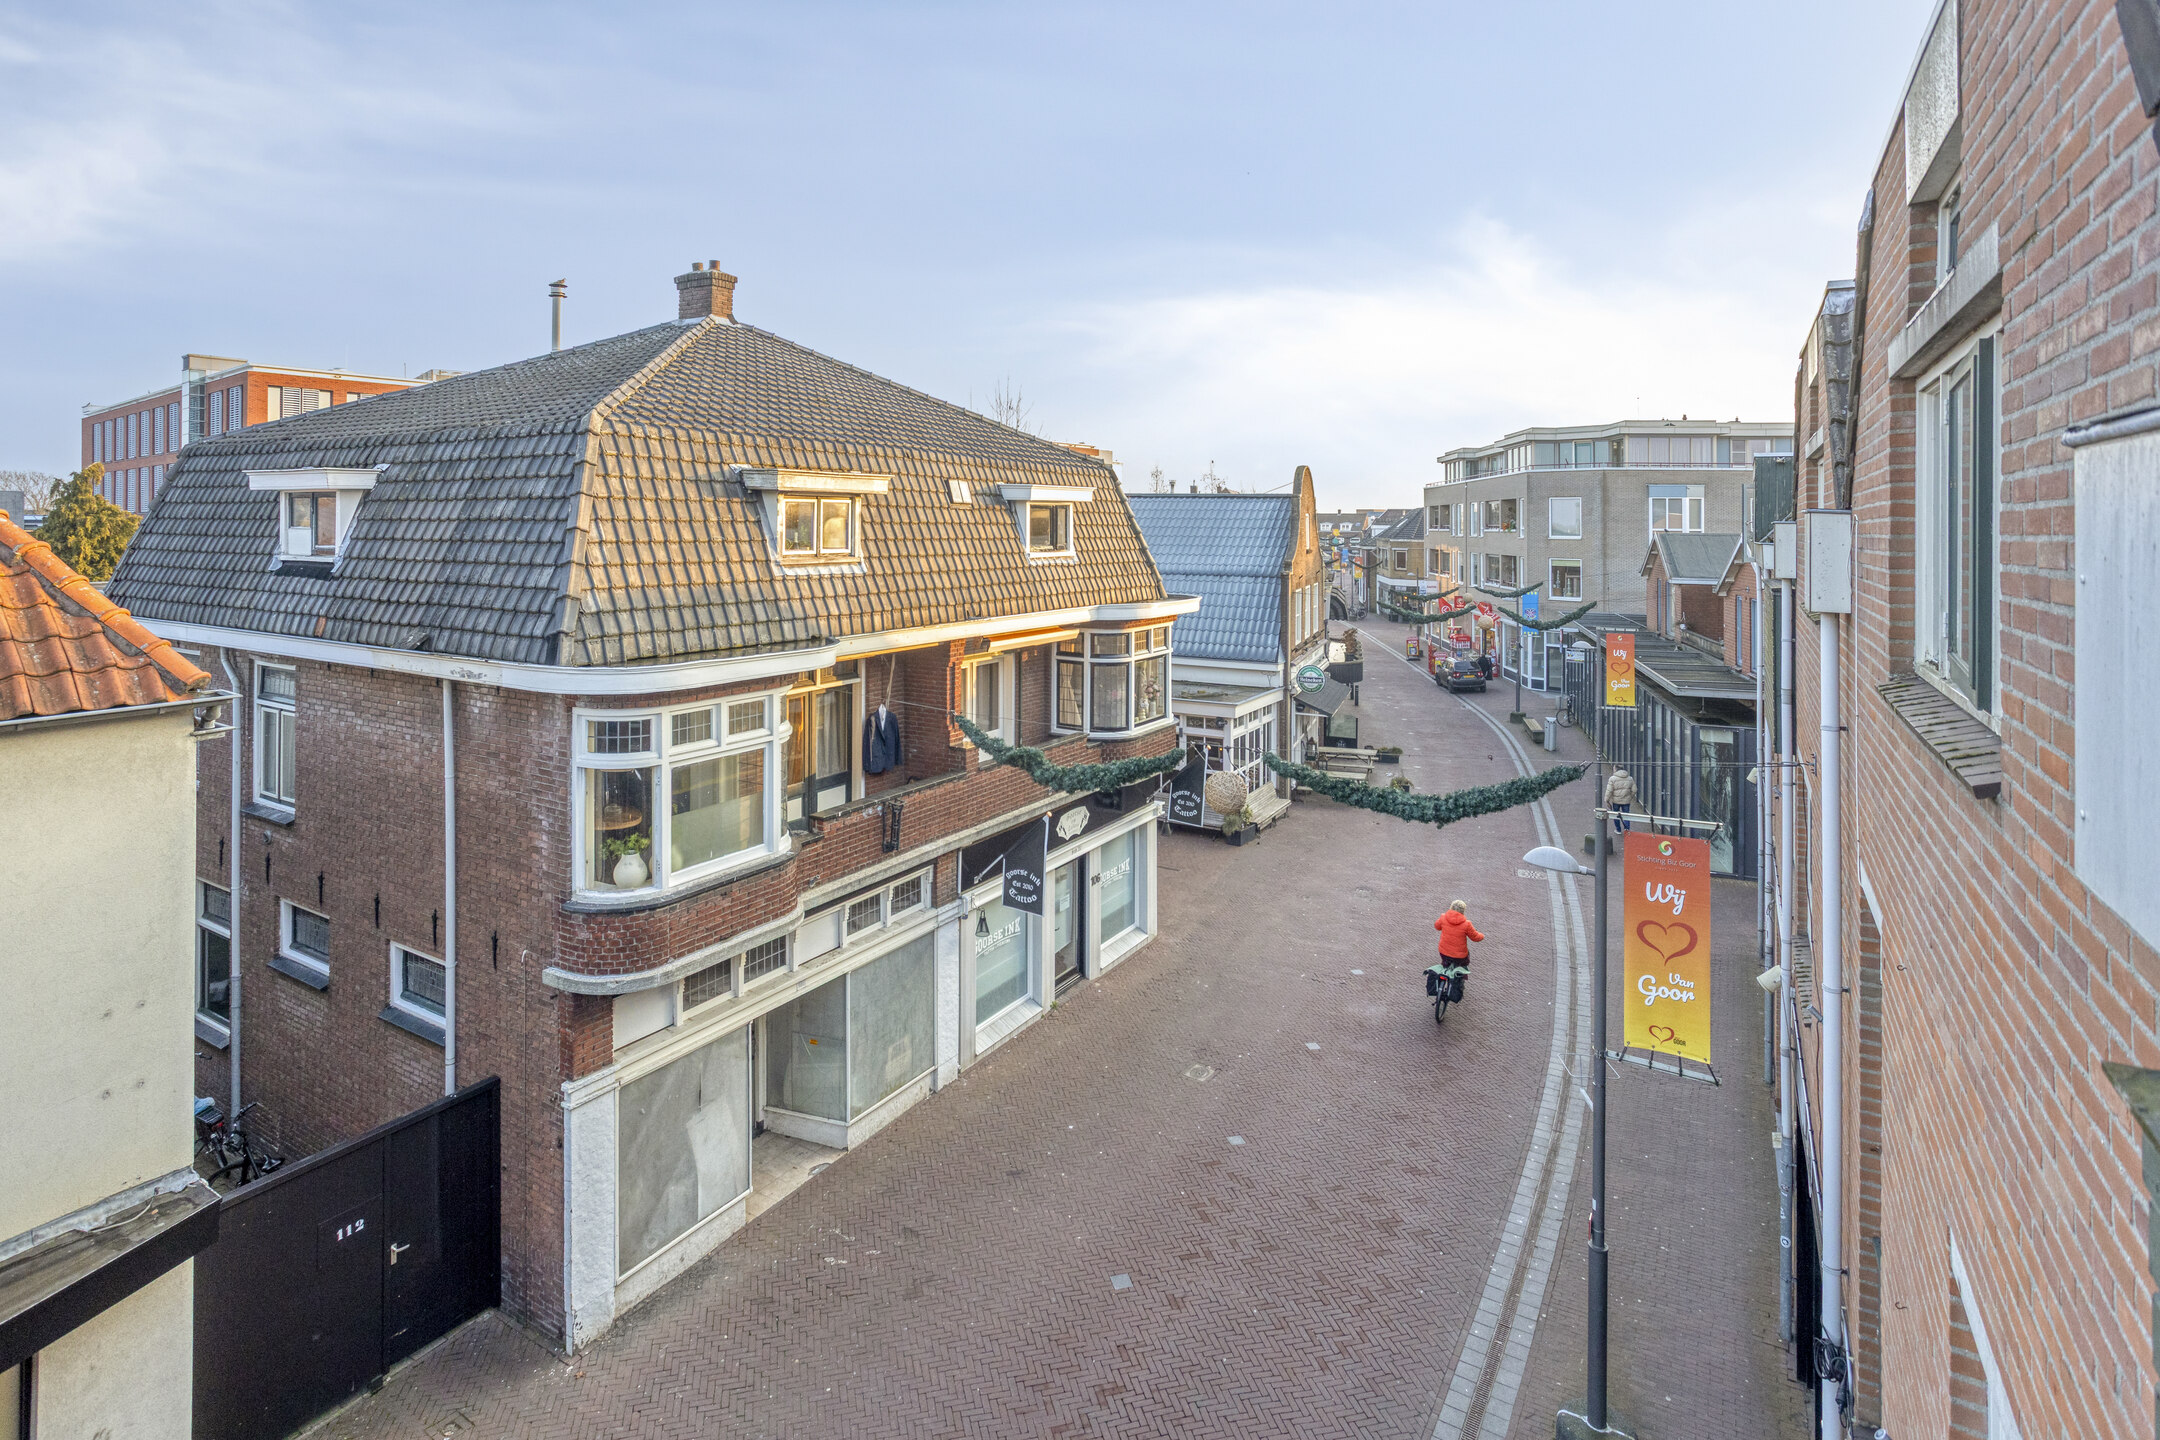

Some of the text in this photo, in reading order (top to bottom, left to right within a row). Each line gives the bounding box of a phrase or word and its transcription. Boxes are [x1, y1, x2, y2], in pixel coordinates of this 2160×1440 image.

[1611, 680, 1630, 691] Goor
[1174, 805, 1198, 817] Tattoo
[1636, 854, 1666, 866] Stichting
[1678, 860, 1697, 868] Goor
[1005, 869, 1041, 887] goorse ink
[1012, 880, 1034, 891] Est 2010
[1090, 872, 1101, 887] 106
[1008, 887, 1038, 904] Tattoo
[1645, 881, 1687, 915] Wij
[1004, 916, 1021, 937] INK
[1668, 972, 1695, 989] Van
[1637, 974, 1696, 1007] Goor
[336, 1218, 365, 1241] 112
